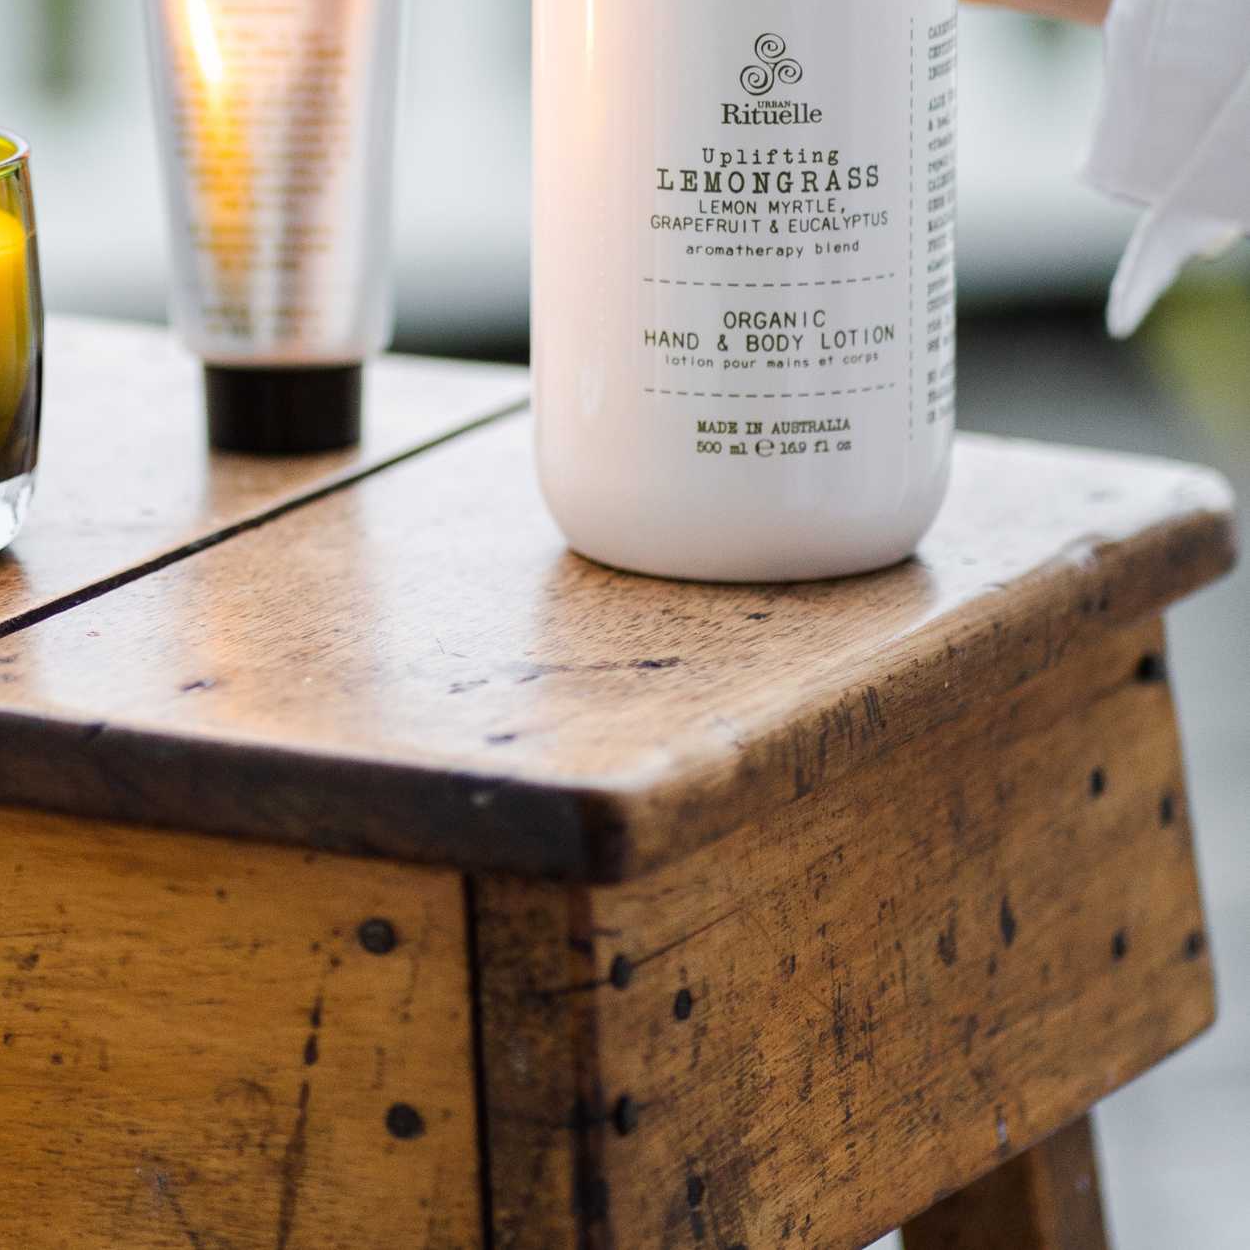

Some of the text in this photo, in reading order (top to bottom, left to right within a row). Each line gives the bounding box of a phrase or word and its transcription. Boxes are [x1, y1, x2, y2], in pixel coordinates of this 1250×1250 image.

[721, 103, 823, 126] Rituelle
[757, 101, 791, 109] URBAN
[702, 148, 839, 167] Uplifting
[656, 165, 879, 194] LEMONGRASS
[699, 198, 846, 215] LEMON MYRTLE,
[650, 211, 888, 234] GRAPEFRUIT & EUCALYPTUS
[686, 241, 860, 259] aromatherapy blend
[723, 310, 826, 329] ORGANIC
[644, 324, 895, 353] HAND & BODY LOTION
[665, 351, 879, 370] lotion pour mains et corps
[697, 418, 851, 435] MADE IN AUSTRALIA
[696, 441, 722, 454] 500
[729, 442, 748, 455] ml
